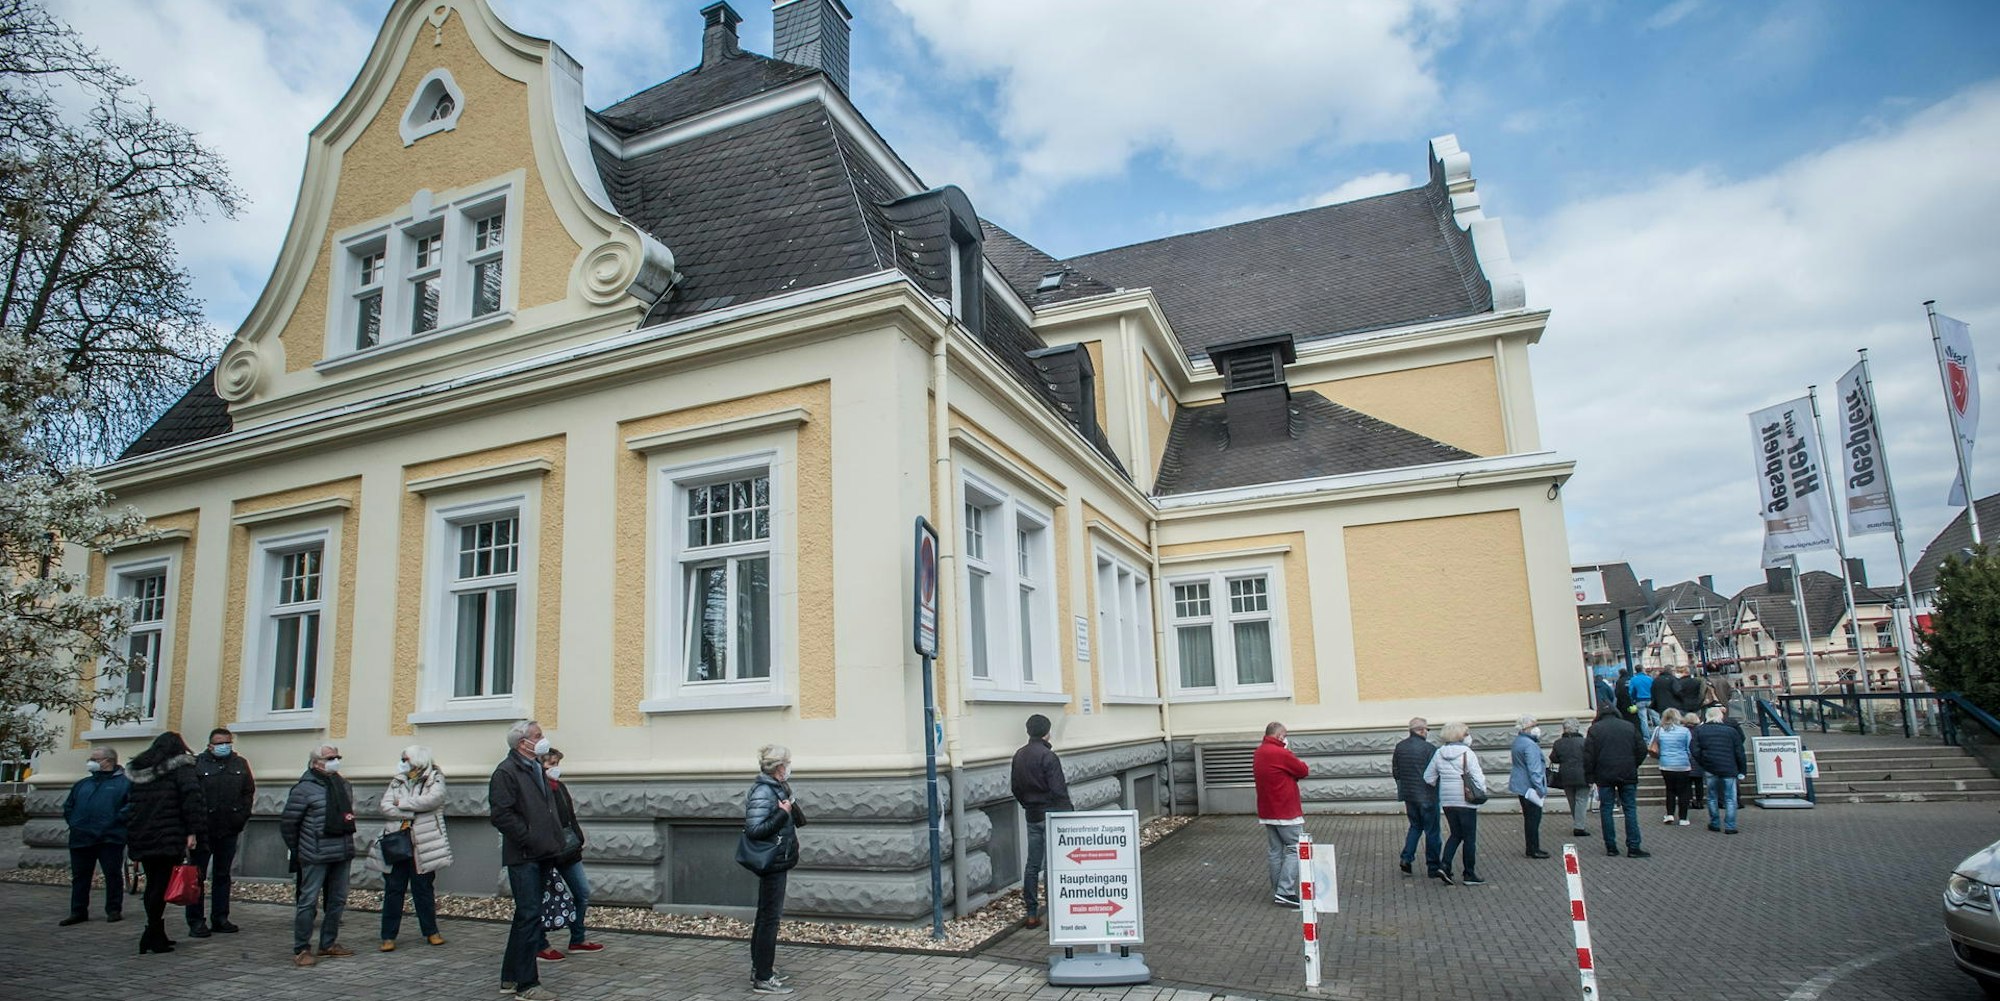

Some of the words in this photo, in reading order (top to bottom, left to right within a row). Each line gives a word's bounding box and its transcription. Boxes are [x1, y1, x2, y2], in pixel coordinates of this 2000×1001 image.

[1101, 825, 1125, 833] Zugang
[1058, 833, 1127, 847] Anmeldung
[1060, 873, 1128, 885] Haupteingang
[1059, 886, 1128, 900] Anmeldung
